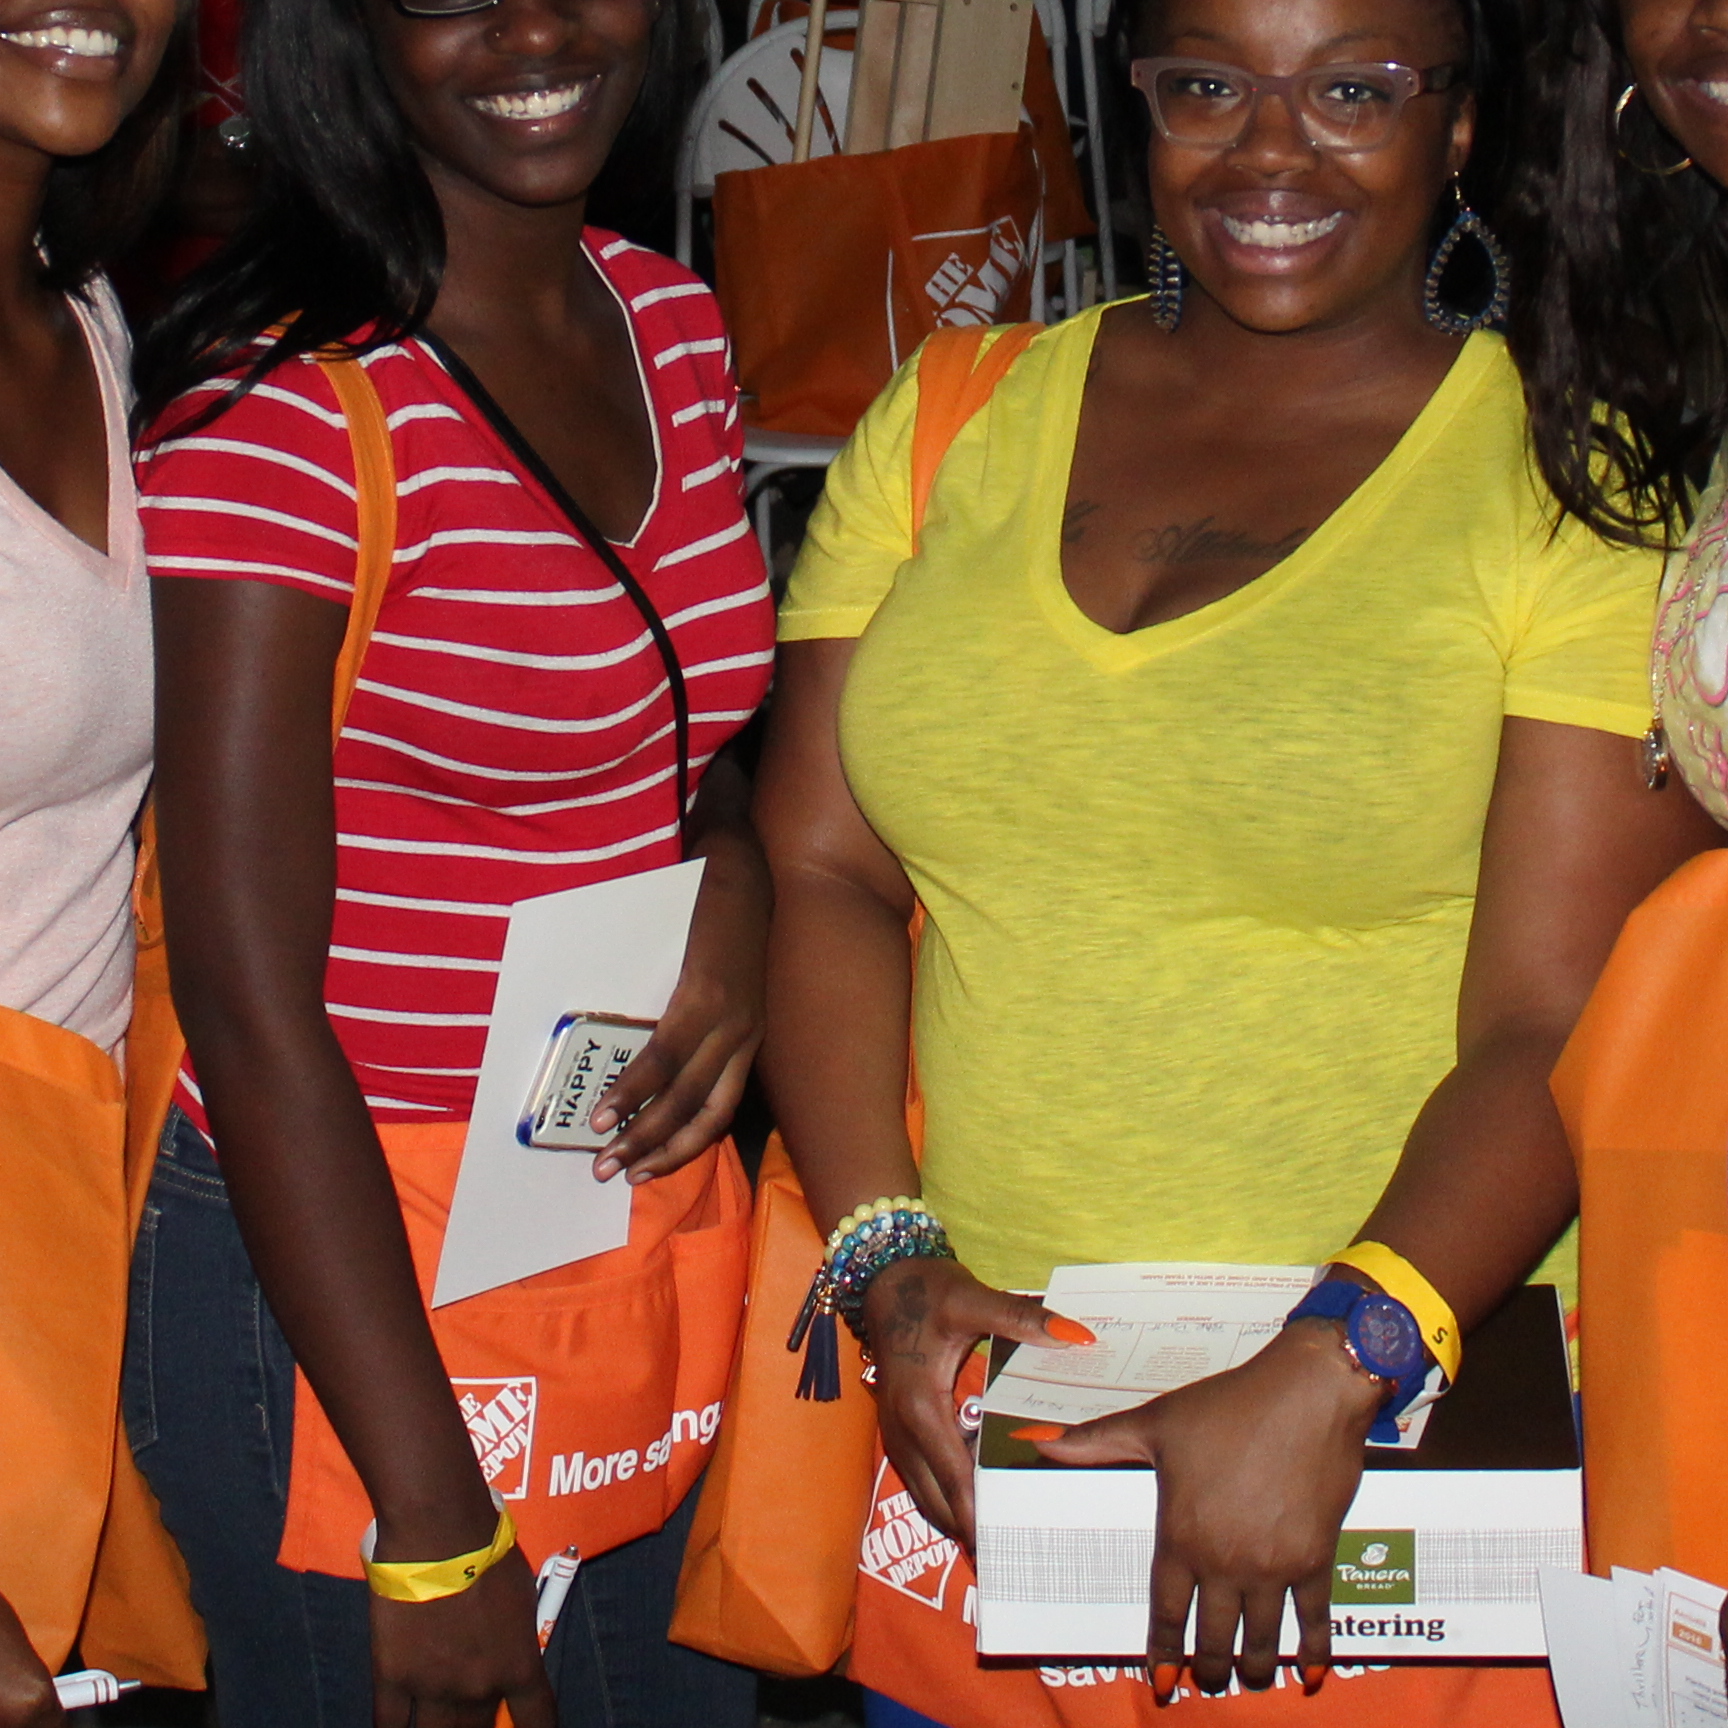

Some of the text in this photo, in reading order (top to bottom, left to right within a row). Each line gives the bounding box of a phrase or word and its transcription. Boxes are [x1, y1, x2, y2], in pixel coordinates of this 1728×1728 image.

[924, 252, 974, 308] HE
[555, 1037, 603, 1128] HAPPY
[479, 1422, 530, 1484] EPOT
[548, 1448, 638, 1497] More
[863, 1510, 946, 1573] HOM
[1335, 1562, 1411, 1583] Panera
[1330, 1613, 1446, 1642] atering
